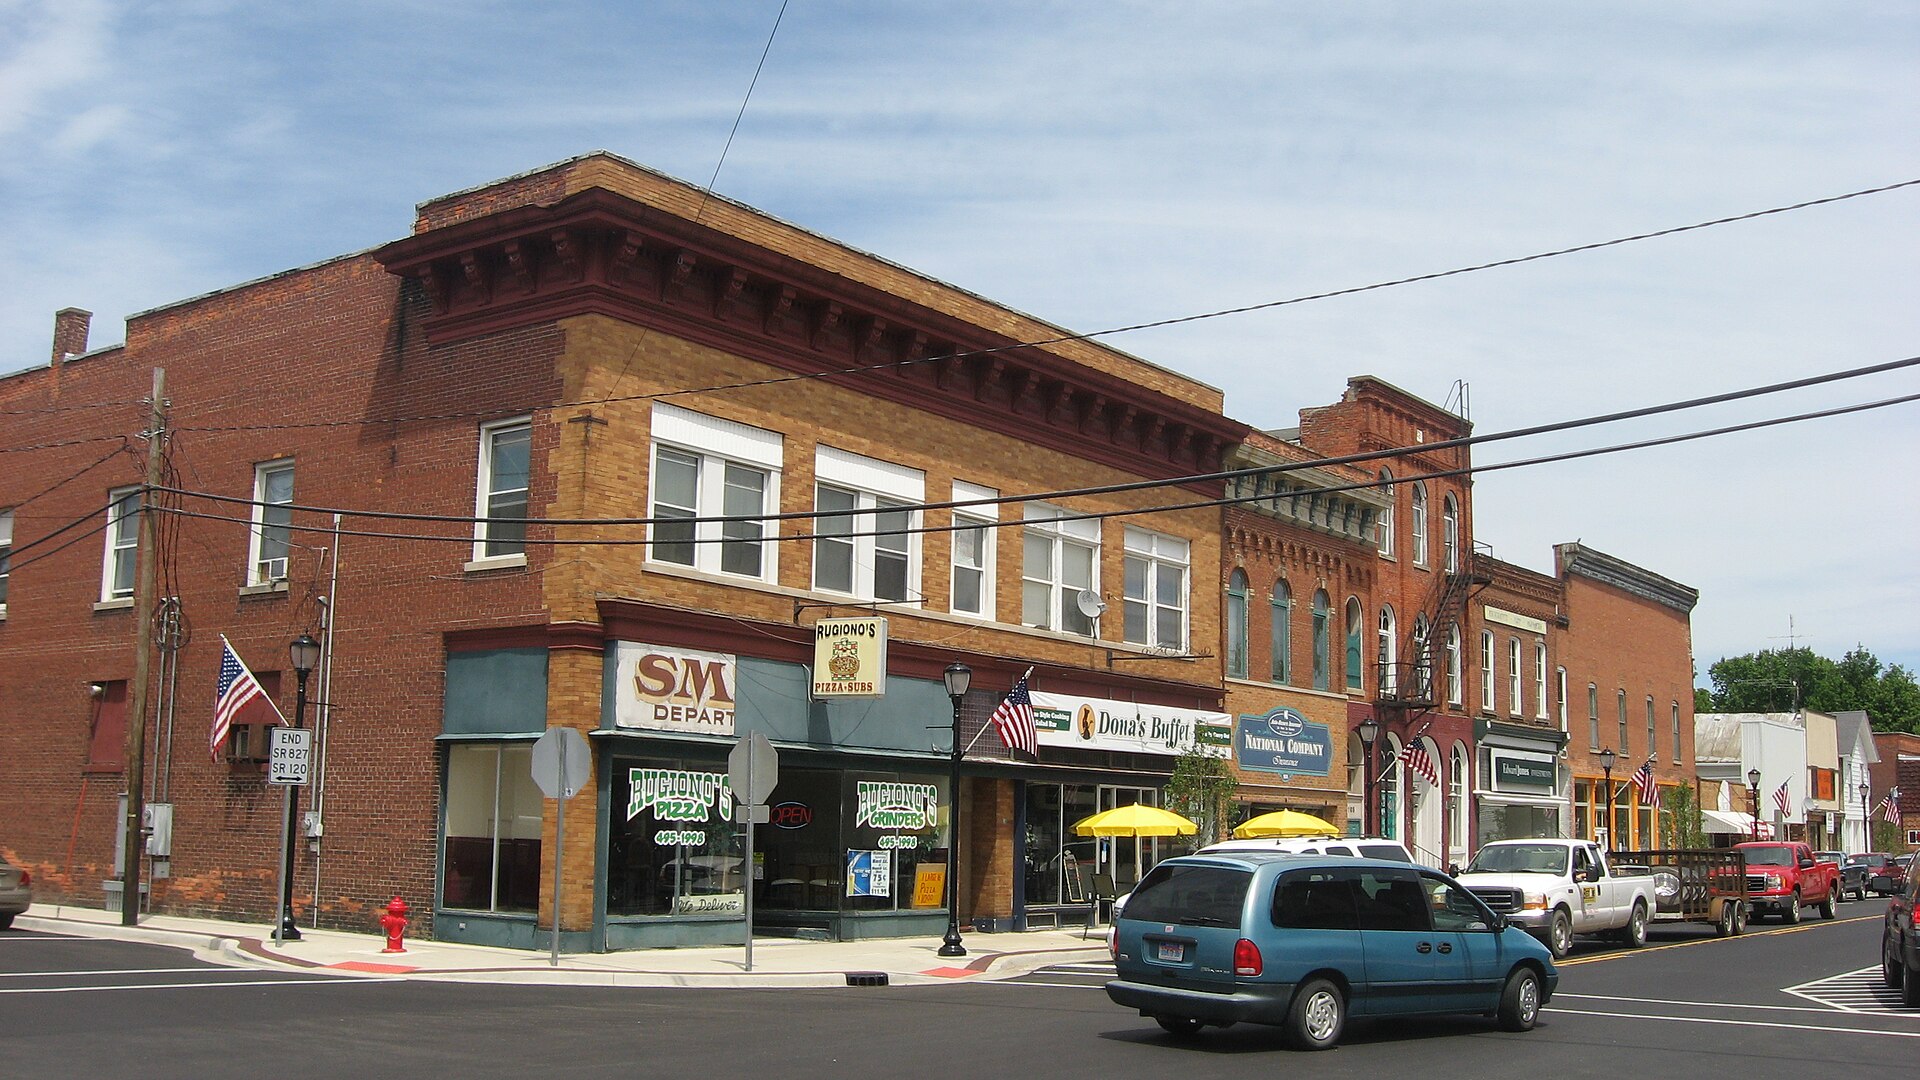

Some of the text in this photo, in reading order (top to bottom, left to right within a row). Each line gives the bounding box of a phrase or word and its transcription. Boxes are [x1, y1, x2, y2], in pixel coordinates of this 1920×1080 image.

[817, 623, 876, 639] RUGIONO'S
[634, 654, 734, 707] SM
[654, 704, 734, 726] DEPART
[282, 733, 302, 744] END
[1098, 711, 1190, 749] Dona's Buffet
[273, 748, 308, 759] SR 827
[1245, 734, 1324, 756] NATIONAL COMPANY
[272, 763, 306, 774] SR 120
[627, 768, 732, 821] RUGIONO'S
[654, 800, 708, 822] PIZZA
[856, 781, 938, 828] RUGIONO'S
[771, 808, 812, 823] OPEN
[868, 810, 925, 830] GRINDERS
[655, 830, 705, 846] 495-1998
[878, 836, 917, 849] 495-1998
[680, 898, 740, 912] We Deliver
